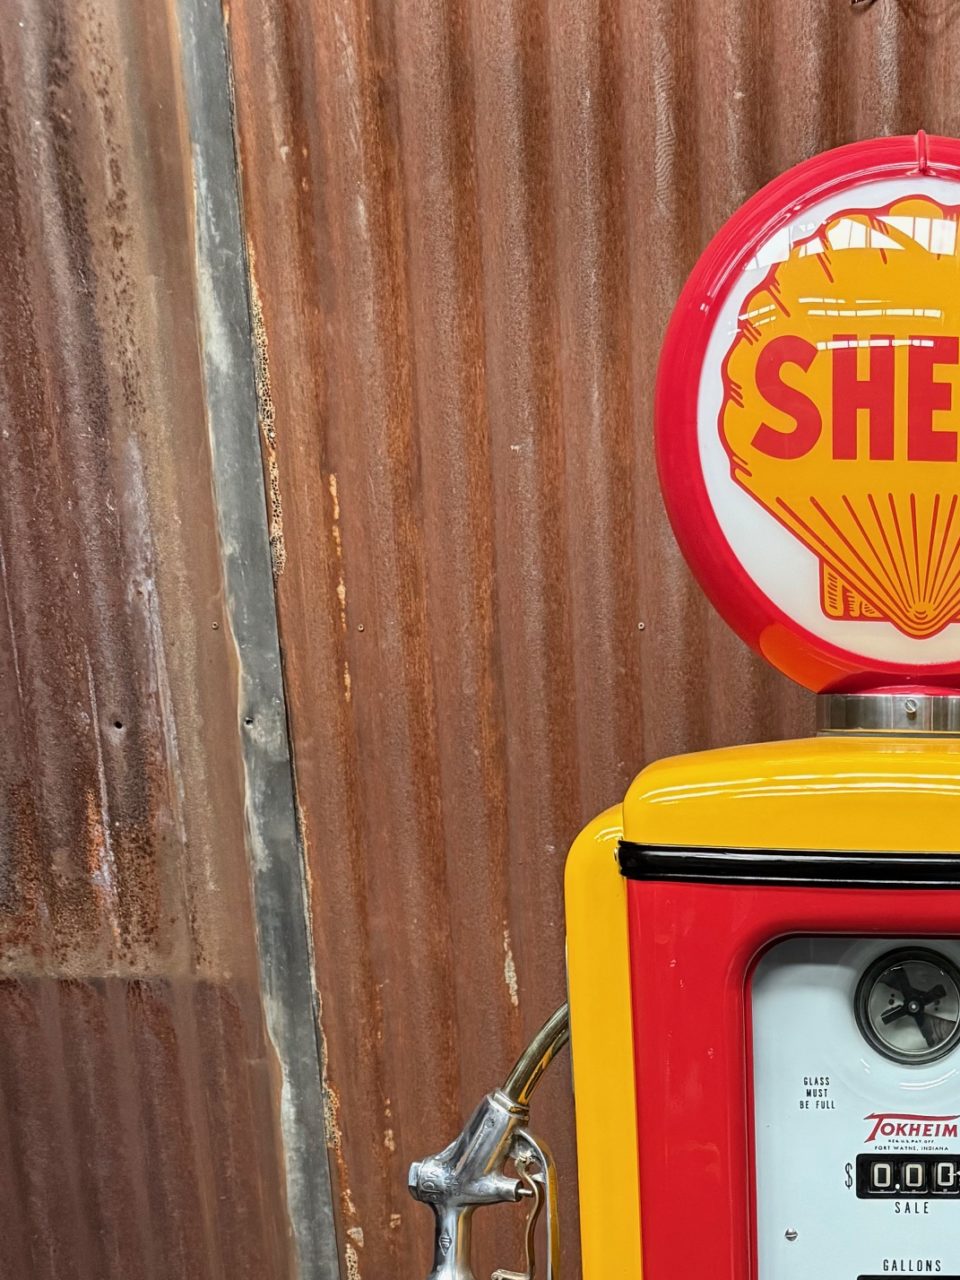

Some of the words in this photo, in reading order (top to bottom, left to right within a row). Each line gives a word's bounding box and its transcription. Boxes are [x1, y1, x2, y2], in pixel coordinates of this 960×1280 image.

[803, 1076, 830, 1086] GLASS
[806, 1088, 828, 1098] MUST
[799, 1100, 809, 1110] BE
[815, 1100, 836, 1110] FULL
[844, 1162, 853, 1190] $
[894, 1201, 929, 1214] SALE
[882, 1259, 942, 1272] GALLONS
